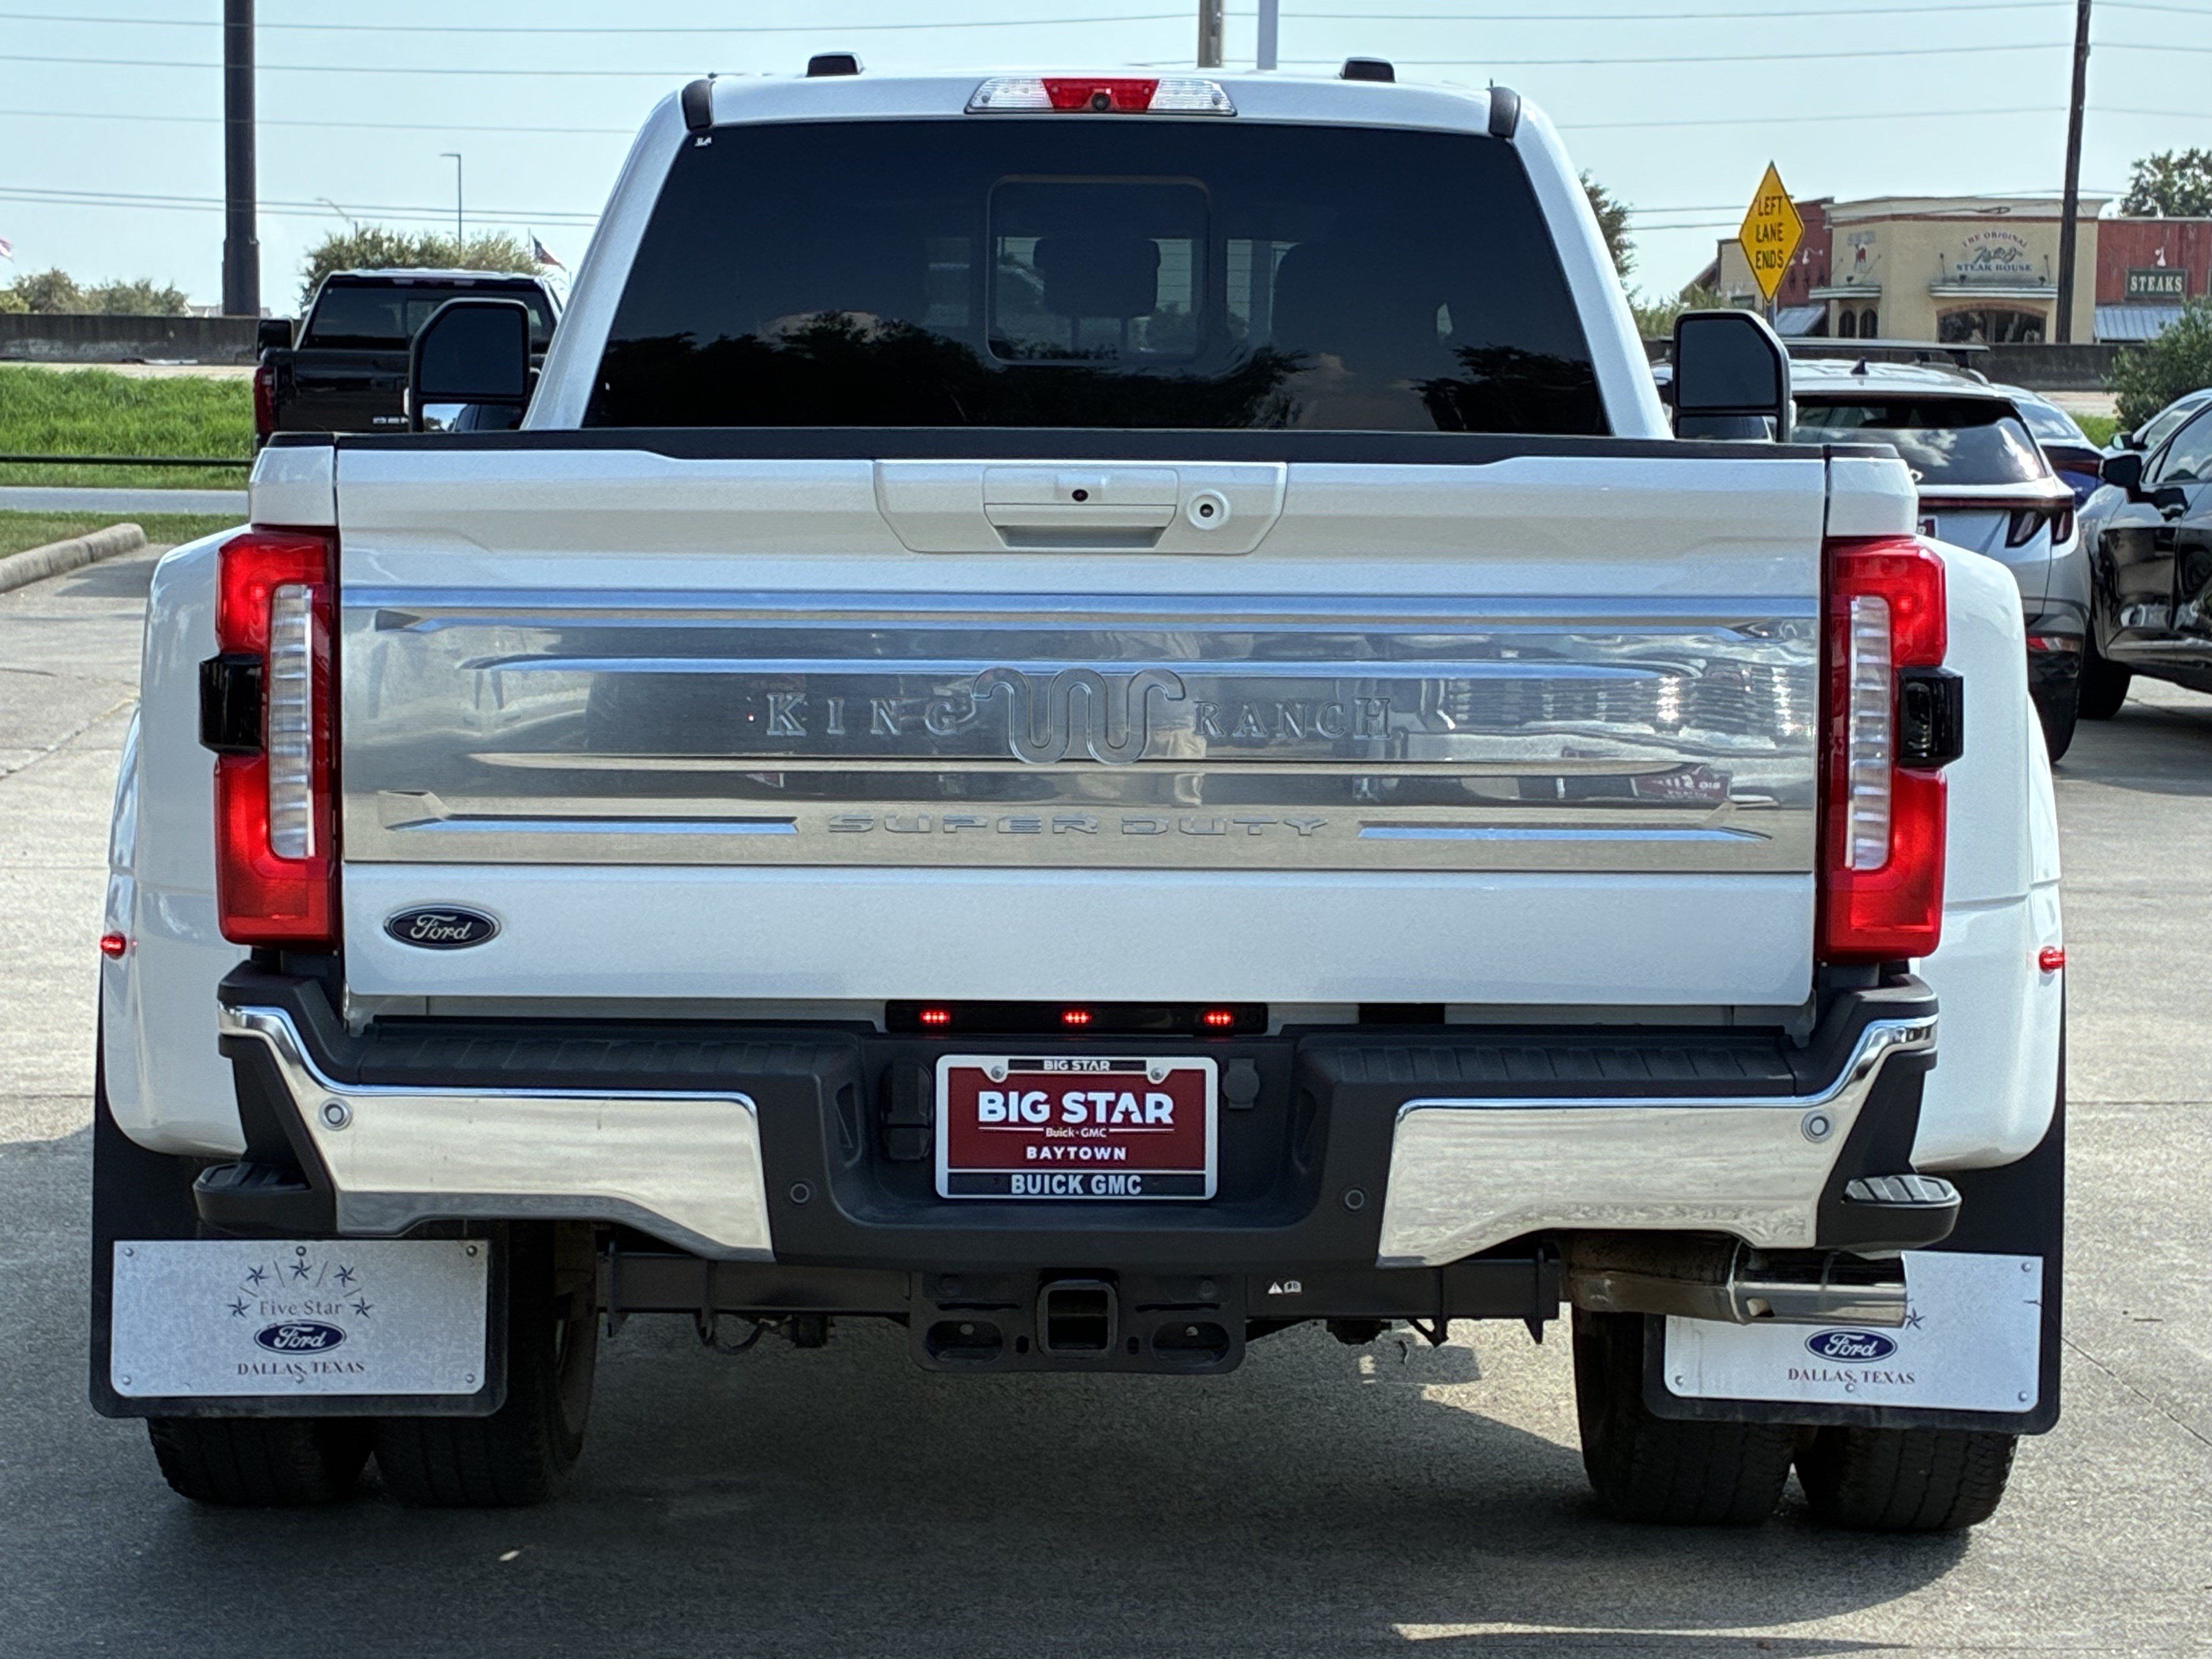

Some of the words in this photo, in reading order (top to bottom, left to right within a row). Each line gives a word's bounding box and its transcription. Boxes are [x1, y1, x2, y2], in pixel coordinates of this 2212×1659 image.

[1758, 195, 1783, 217] LEFT
[1756, 222, 1784, 243] LANE
[1756, 250, 1784, 270] ENDS
[1956, 263, 1992, 272] STEAK
[2130, 275, 2182, 292] STEAKS
[766, 693, 958, 737] KING
[1195, 696, 1391, 741] RANCH
[828, 814, 1098, 833] SUPER
[1121, 816, 1329, 837] DUTY
[410, 914, 473, 940] Ford
[1043, 1060, 1069, 1071] BIG
[1072, 1061, 1110, 1071] STAR
[978, 1091, 1050, 1122] BIG
[1062, 1092, 1174, 1124] STAR
[1046, 1127, 1075, 1138] Buick
[1081, 1127, 1107, 1138] GMC
[1026, 1146, 1126, 1161] BAYTOWN
[1011, 1174, 1084, 1194] BUICK
[1091, 1175, 1142, 1195] GMC
[260, 1300, 298, 1316] Five
[304, 1300, 342, 1315] Star
[273, 1325, 327, 1348] Ford
[1825, 1334, 1877, 1356] Ford
[312, 1361, 365, 1374] TEXAS
[1861, 1370, 1916, 1384] TEXAS
